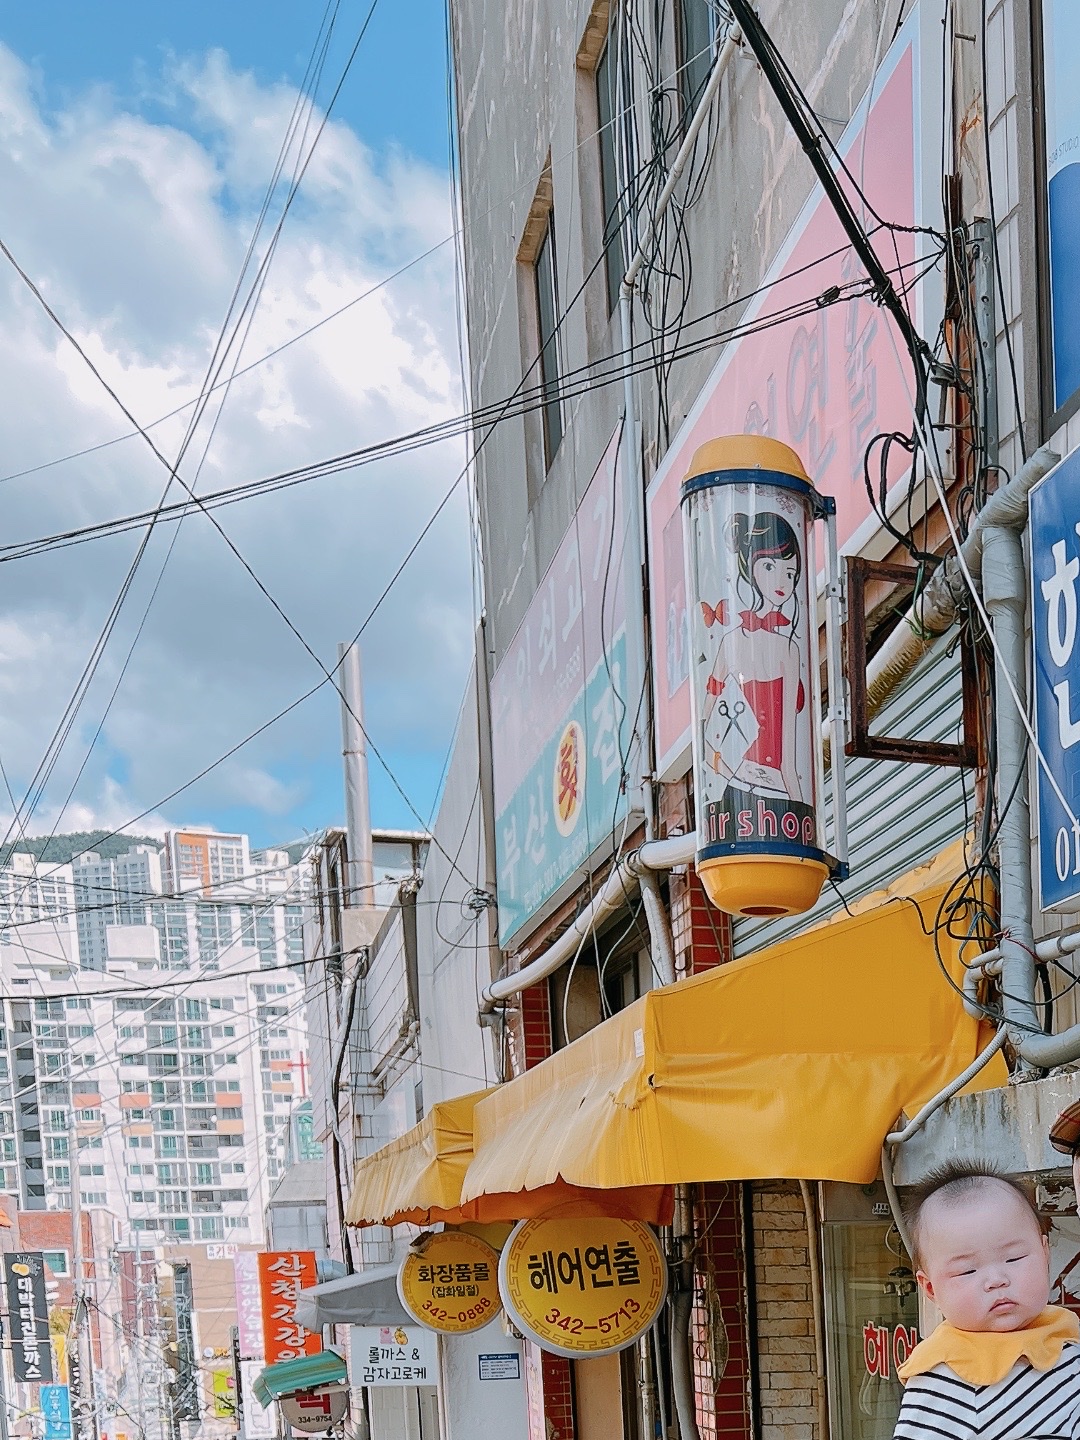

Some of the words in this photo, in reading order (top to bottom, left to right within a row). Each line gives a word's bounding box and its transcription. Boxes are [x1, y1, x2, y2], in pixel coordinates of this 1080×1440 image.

[737, 799, 814, 846] shop
[418, 1262, 490, 1284] 화장품몰
[527, 1240, 641, 1294] 헤어연출
[422, 1297, 491, 1323] 342-0888
[545, 1298, 641, 1335] 342-5713
[368, 1346, 407, 1363] 롤까스
[411, 1348, 420, 1360] &
[363, 1366, 427, 1382] 감자고로케
[297, 1415, 333, 1424] 334-9754
